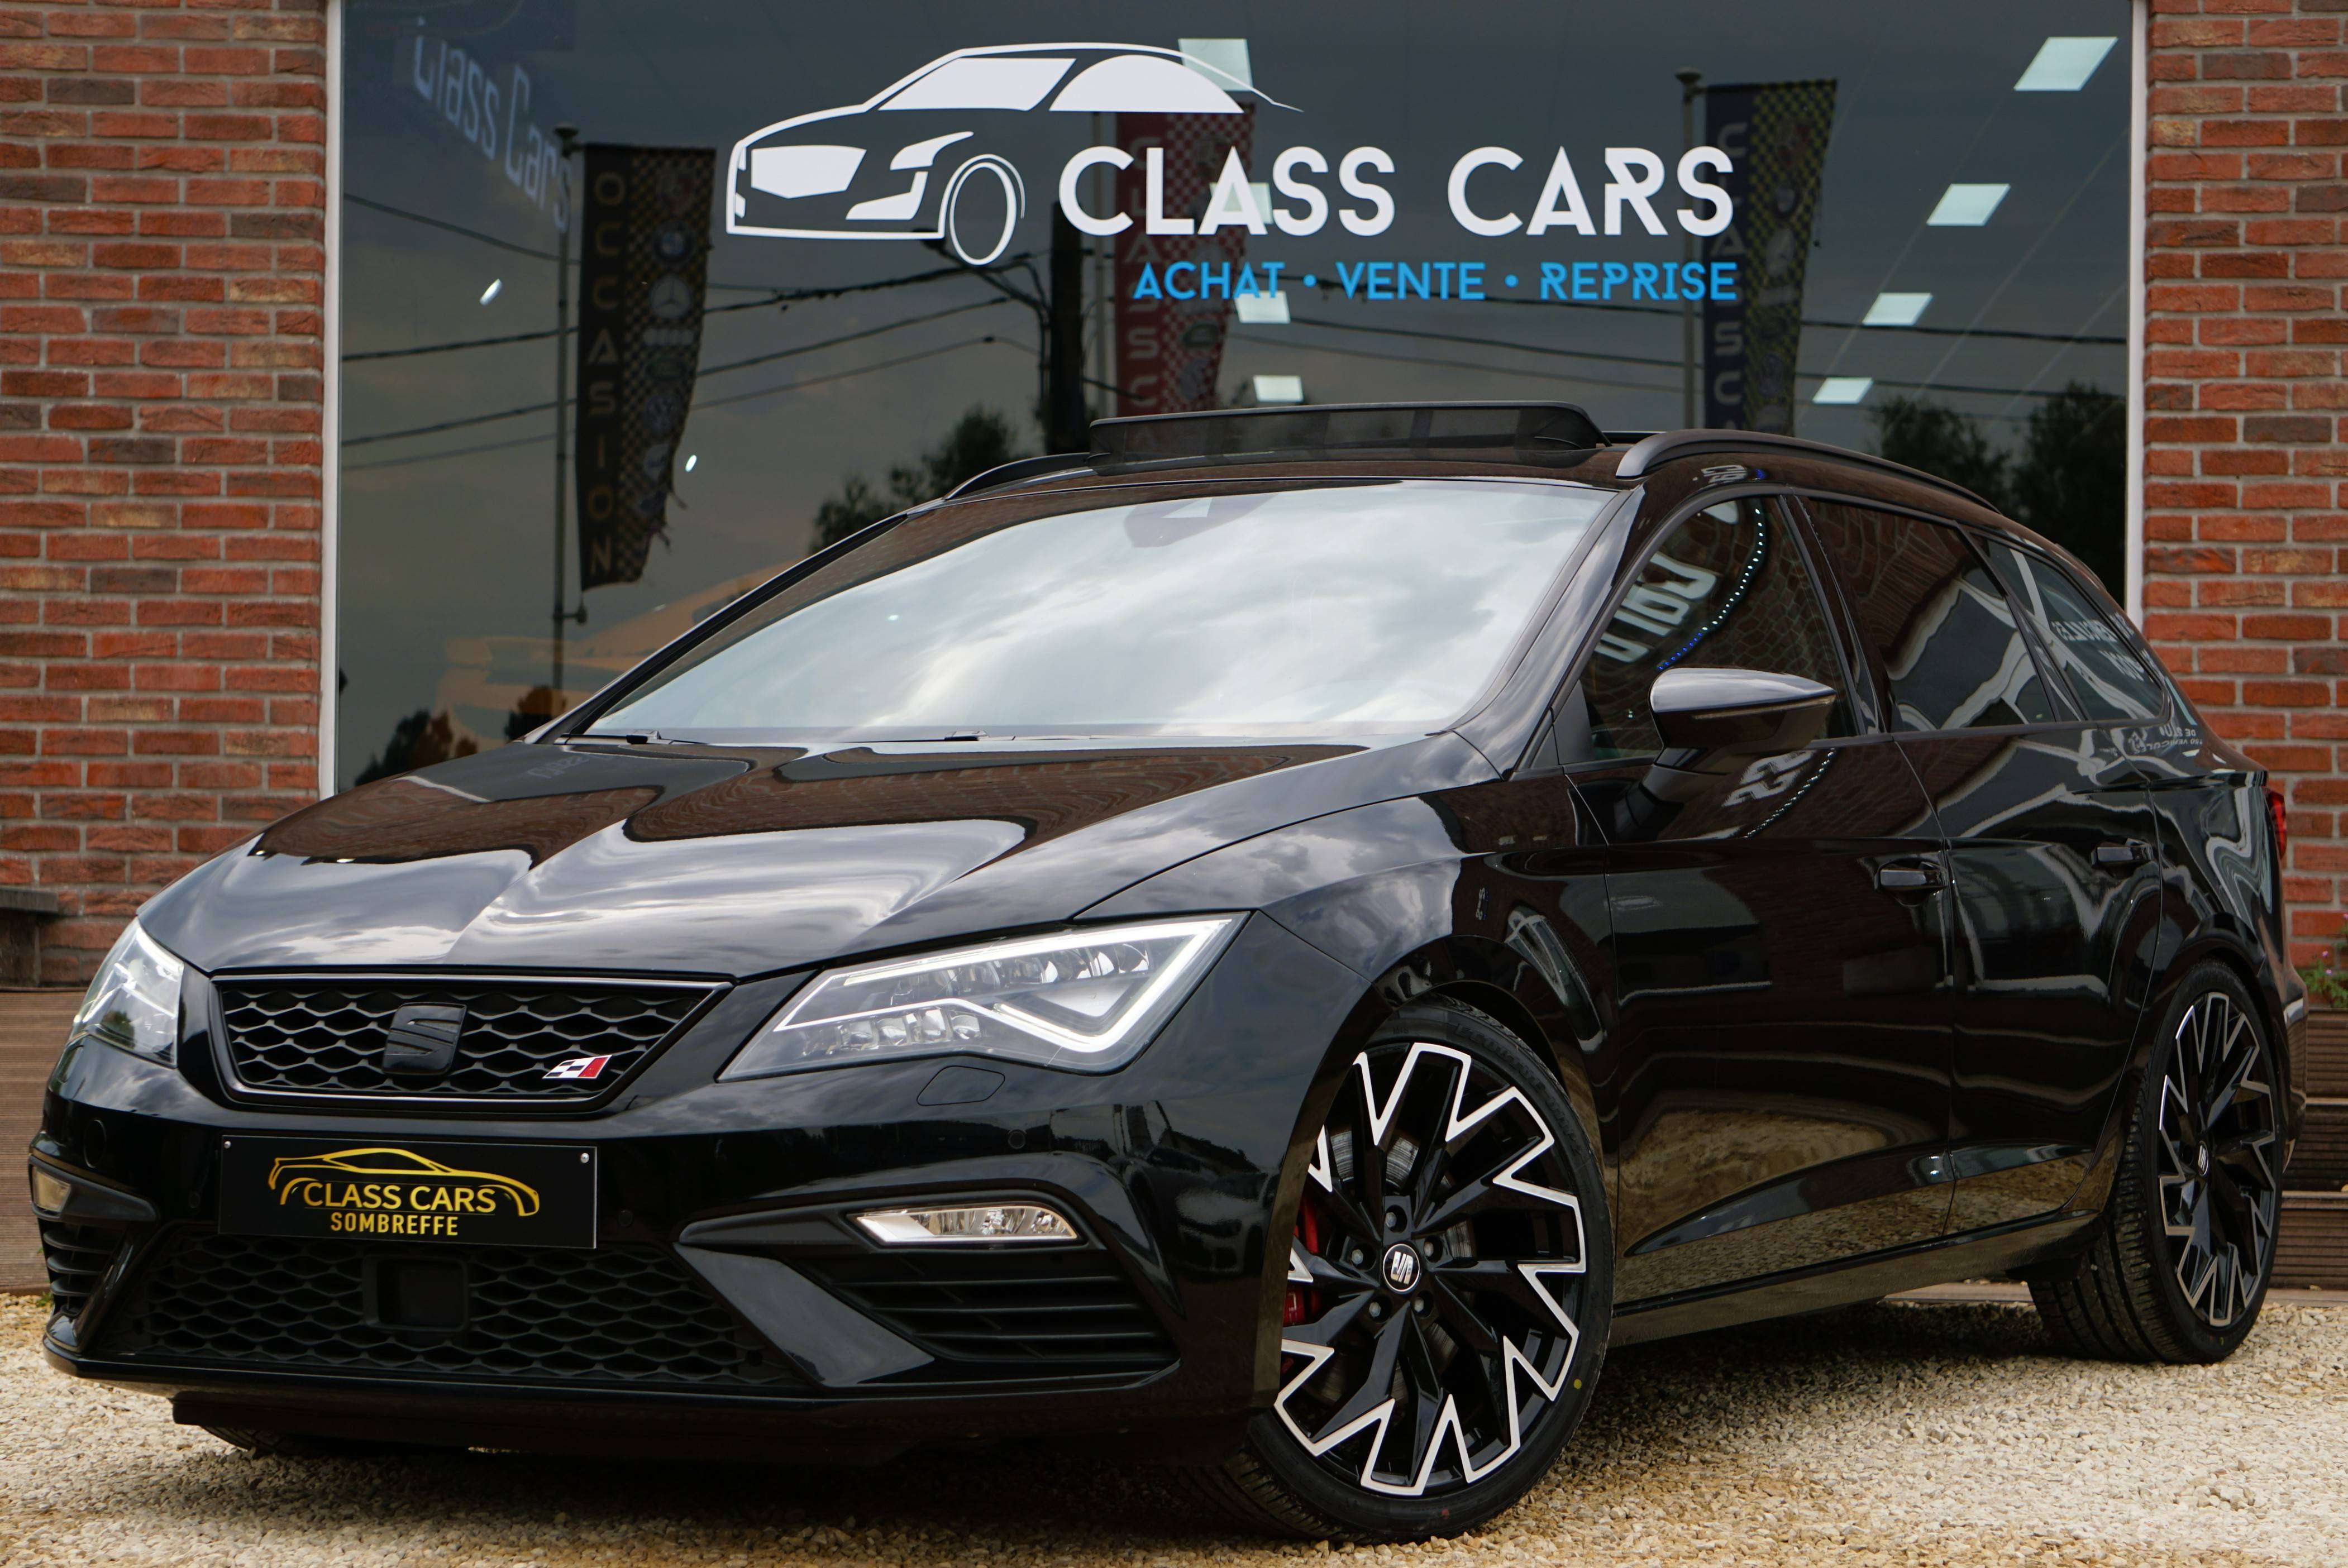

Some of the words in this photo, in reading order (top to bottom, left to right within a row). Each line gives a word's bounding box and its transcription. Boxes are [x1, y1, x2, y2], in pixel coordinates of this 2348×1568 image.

[1060, 146, 1395, 236] CLASS
[1447, 146, 1733, 236] CARS
[1134, 261, 1285, 300] ACHAT
[1336, 262, 1485, 300] VENTE
[1540, 262, 1736, 300] REPRISE
[587, 170, 626, 576] OCCASION
[303, 1182, 402, 1210] CLASS
[409, 1185, 497, 1213] CARS
[331, 1211, 459, 1236] SOMBREFFE
